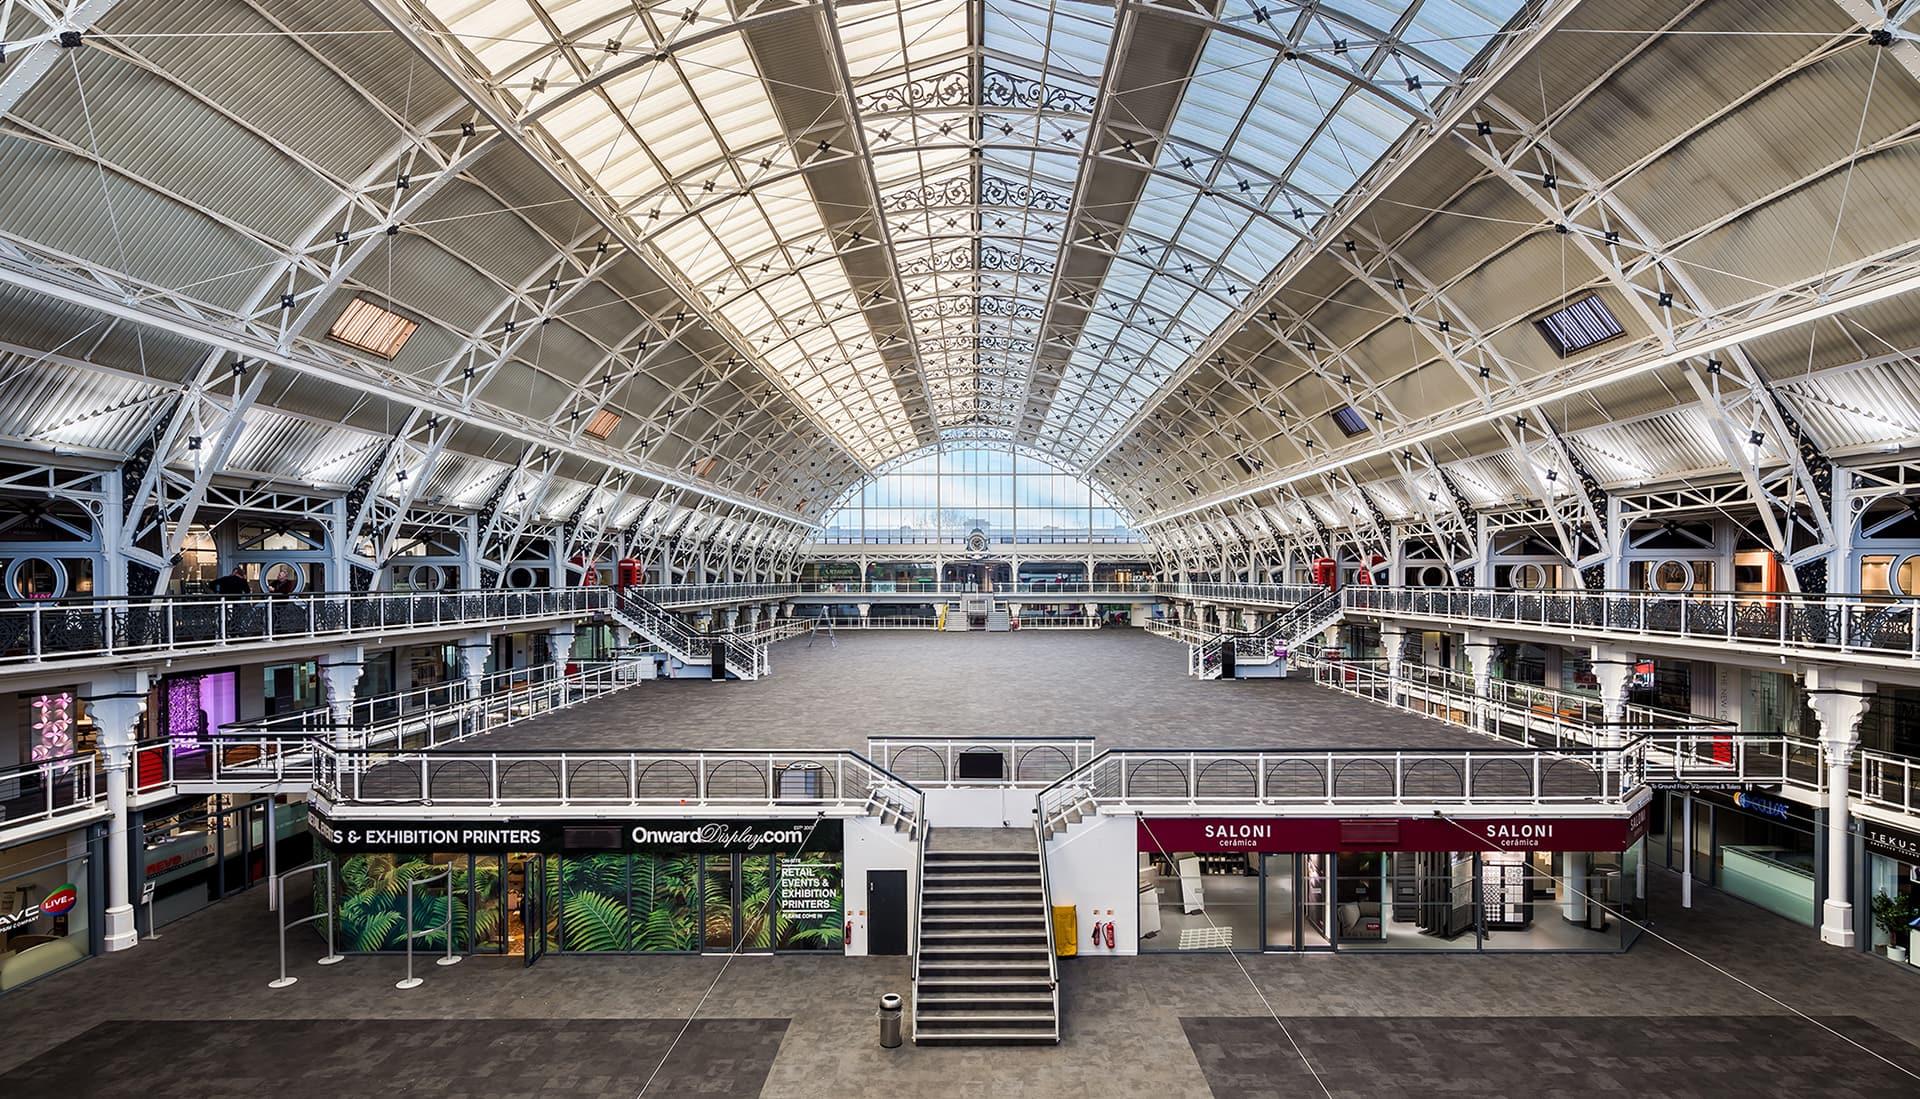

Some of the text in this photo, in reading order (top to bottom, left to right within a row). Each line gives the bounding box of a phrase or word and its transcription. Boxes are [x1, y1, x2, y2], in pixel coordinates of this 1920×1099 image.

[1205, 824, 1271, 838] SALONI
[1486, 824, 1553, 838] SALONI
[347, 830, 361, 844] &
[366, 830, 458, 844] EXHIBITION
[463, 830, 541, 844] PRINTERS
[1219, 838, 1257, 847] cerámica
[1500, 838, 1539, 847] cerámica
[781, 867, 815, 877] RETAIL
[781, 878, 829, 888] EVENTS &
[781, 889, 837, 898] EXHIBITION
[45, 896, 67, 909] LIVE
[781, 900, 830, 909] PRINTERS
